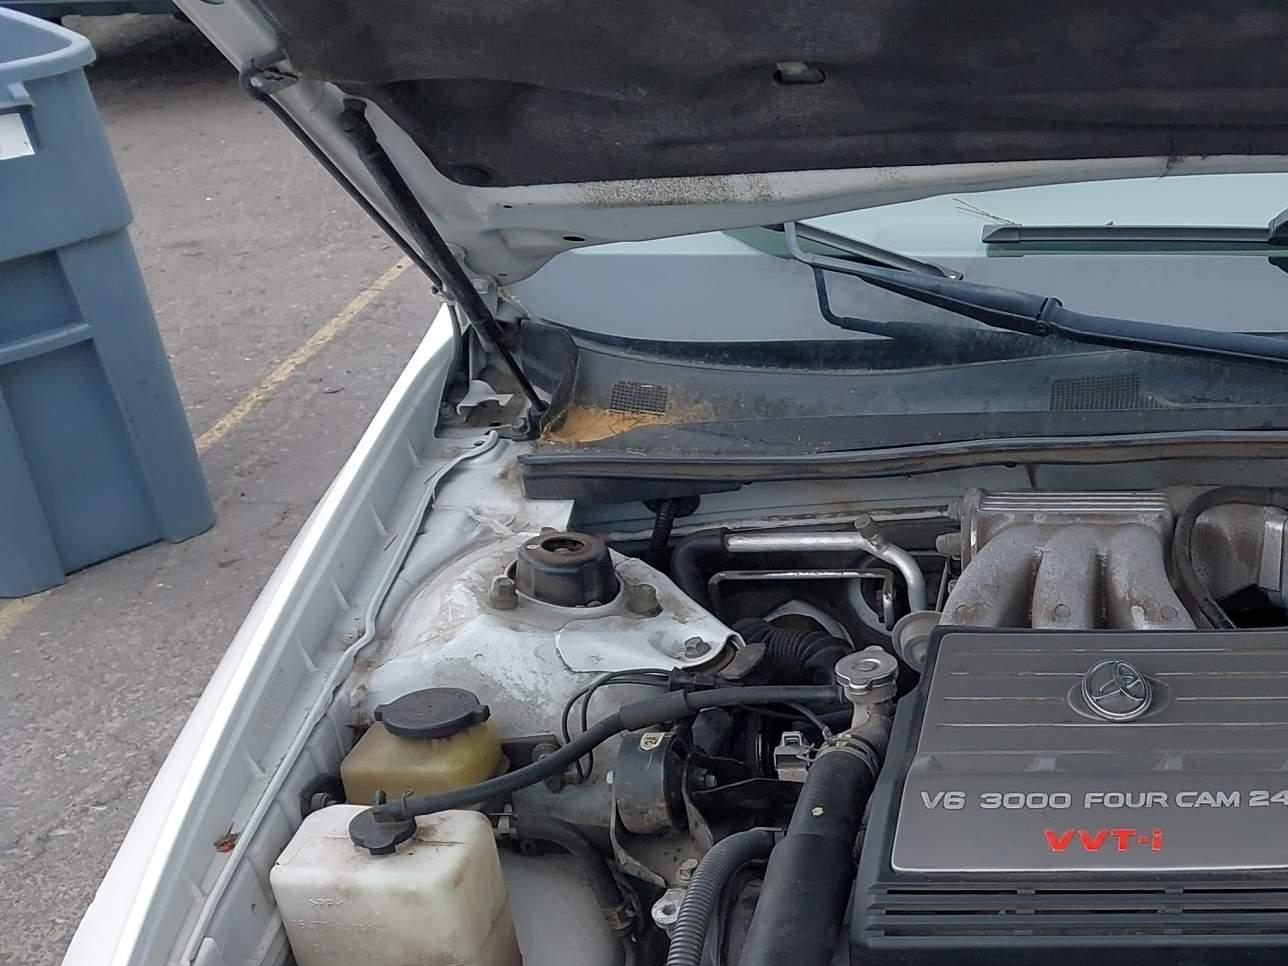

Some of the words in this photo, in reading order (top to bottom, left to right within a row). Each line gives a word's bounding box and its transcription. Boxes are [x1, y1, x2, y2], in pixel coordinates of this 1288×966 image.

[920, 791, 966, 810] V6
[980, 791, 1071, 810] 3000
[1084, 791, 1169, 809] FOUR
[1176, 790, 1240, 808] CAM
[1044, 828, 1163, 852] VVT-i
